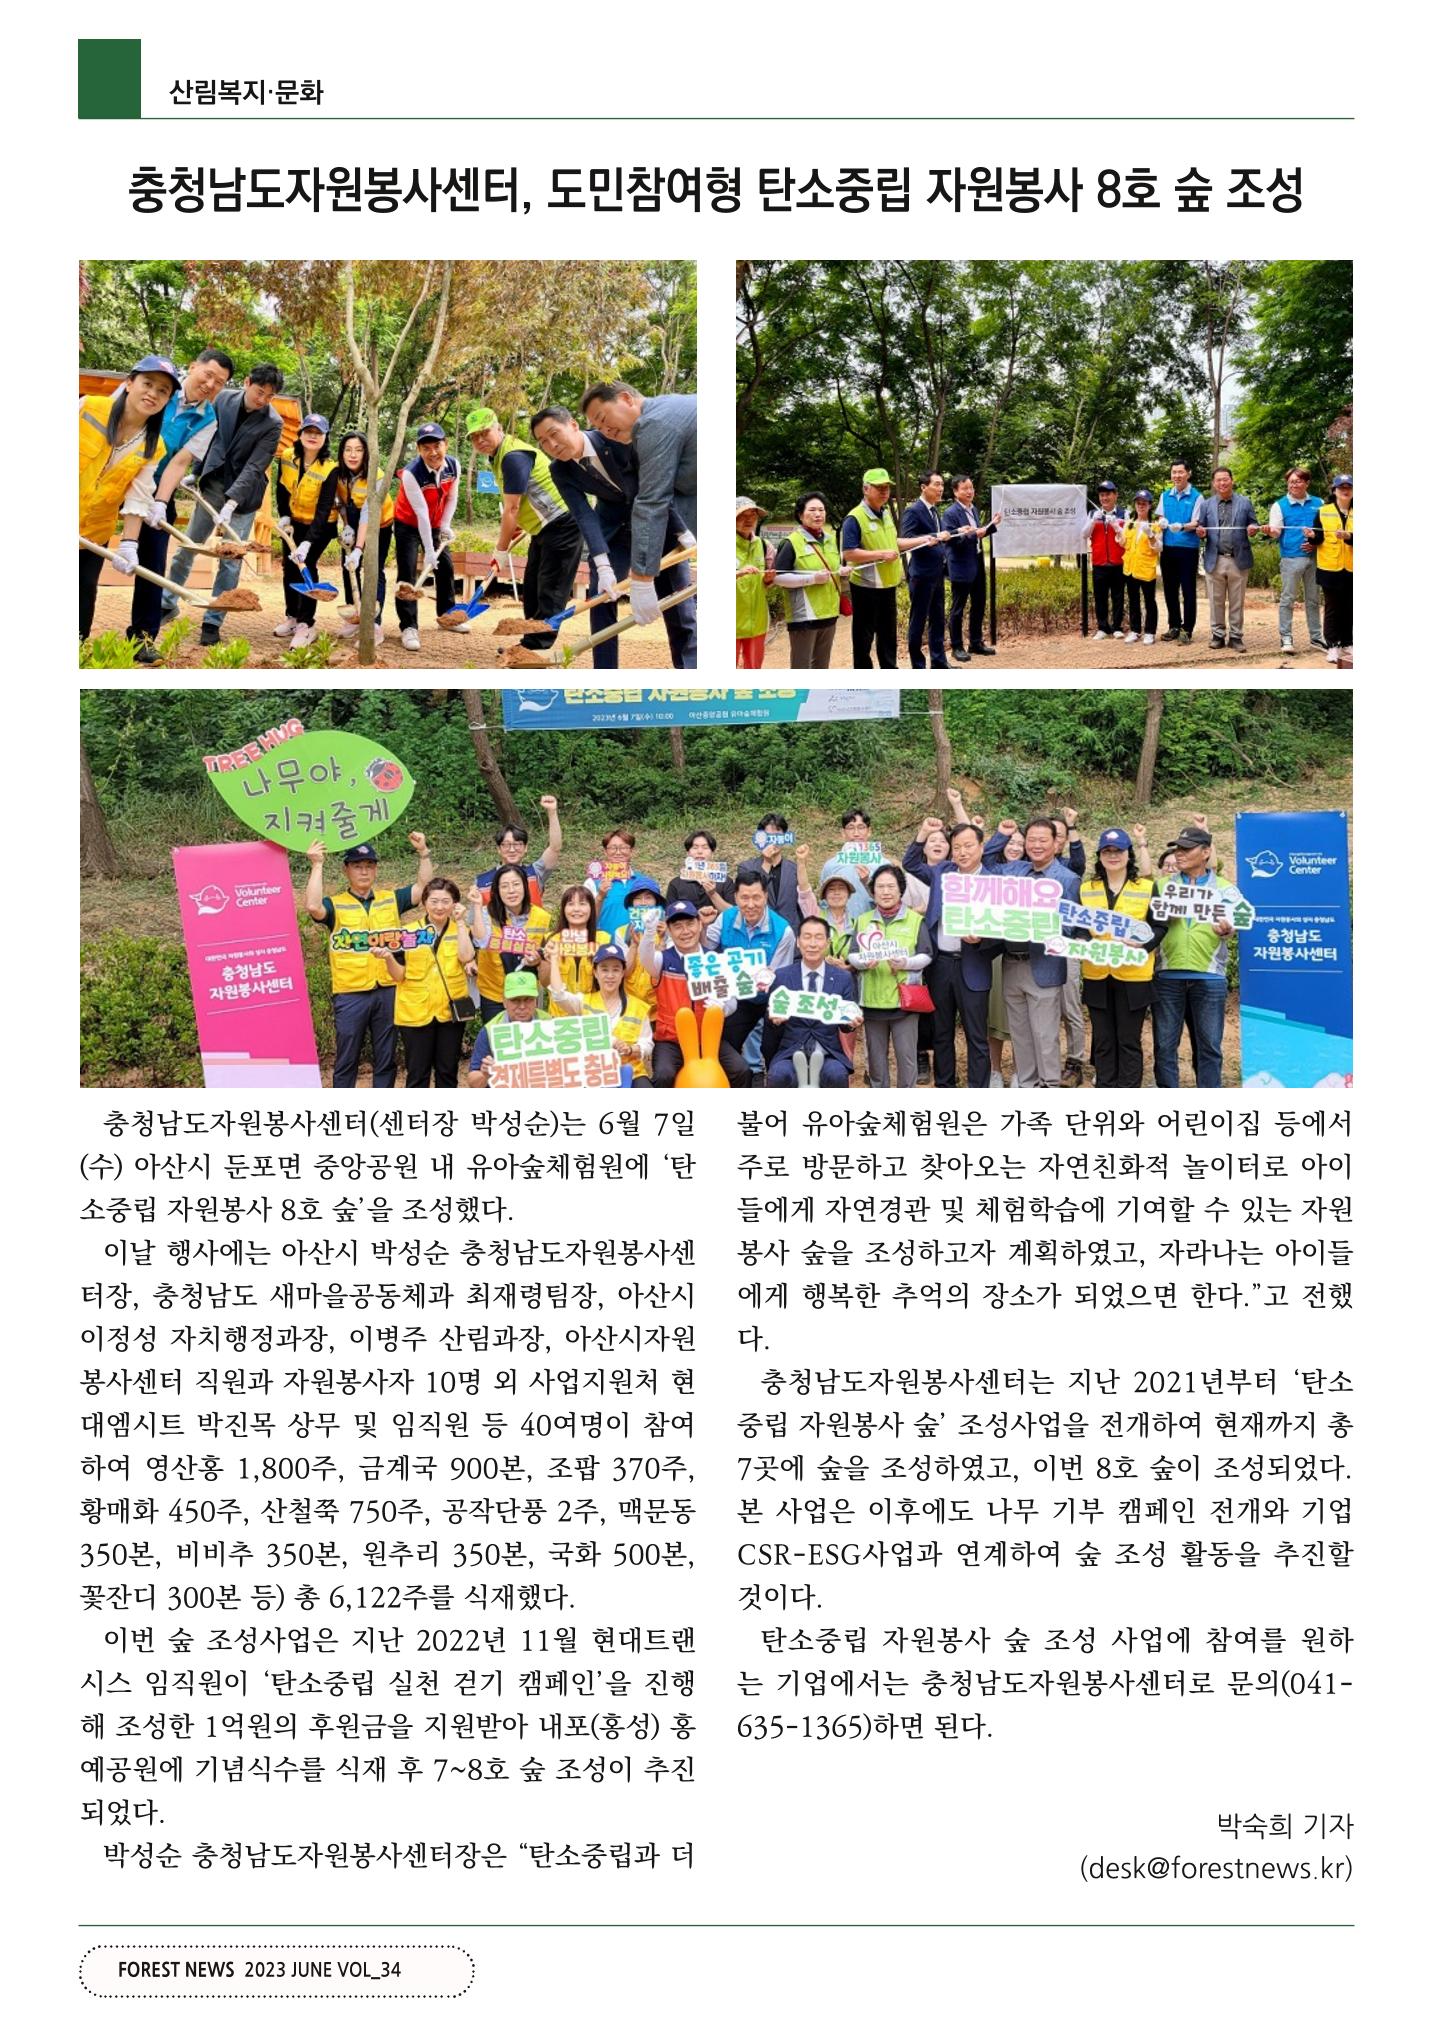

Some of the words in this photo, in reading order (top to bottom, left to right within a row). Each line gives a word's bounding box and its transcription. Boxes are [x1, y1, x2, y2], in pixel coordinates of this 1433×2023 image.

[168, 79, 325, 106] 산림복지·문화
[128, 166, 531, 215] 충청남도자원봉사센터,
[547, 166, 741, 214] 도민참여형
[759, 166, 910, 214] 탄소중립
[926, 166, 1084, 214] 자원봉사
[1097, 167, 1161, 209] 8호
[1174, 166, 1213, 213] 숲
[1226, 166, 1302, 214] 조성
[203, 742, 263, 773] TREE
[258, 718, 305, 751] HUG
[242, 756, 357, 797] 나무야,
[264, 798, 391, 840] 지켜줄게
[1289, 856, 1337, 865] Volunteer
[1289, 865, 1322, 875] Center
[234, 886, 281, 897] Volunteer
[236, 897, 268, 908] Center
[943, 874, 1062, 908] 함께해요
[1164, 884, 1213, 900] 우리가
[943, 905, 1060, 941] 탄소중립
[1059, 901, 1131, 937] 탄소중립
[1152, 900, 1187, 918] 함께
[1194, 904, 1227, 923] 만든
[1233, 901, 1252, 927] 숲
[503, 926, 528, 942] 탄소
[1267, 928, 1322, 944] 충청남도
[687, 954, 721, 979] 좋은
[727, 951, 763, 973] 공기
[1068, 941, 1146, 965] 자원봉사
[1253, 946, 1337, 961] 자원봉사센터
[222, 961, 277, 982] 충청남도
[691, 976, 729, 999] 배출
[736, 970, 755, 996] 숲
[209, 977, 293, 1000] 자원봉사센터
[772, 988, 791, 1015] 숲
[797, 994, 839, 1020] 조성
[492, 1015, 611, 1062] 탄소중립
[490, 1056, 583, 1088] 경제특별도
[583, 1052, 619, 1087] 충남
[103, 1109, 459, 1138] 충청남도자원봉사센터(센터장
[471, 1109, 587, 1138] 박성순)는
[598, 1109, 640, 1137] 6월
[654, 1109, 694, 1137] 7일
[737, 1109, 787, 1138] 불어
[802, 1109, 988, 1138] 유아숲체험원은
[1000, 1109, 1053, 1138] 가족
[1065, 1109, 1145, 1138] 단위와
[1157, 1109, 1259, 1137] 어린이집
[1274, 1109, 1351, 1138] 등에서
[79, 1195, 155, 1224] 소중립
[167, 1195, 273, 1224] 자원봉사
[281, 1197, 323, 1221] 8호
[332, 1196, 394, 1223] 숲’을
[402, 1195, 513, 1224] 조성했다.
[736, 1239, 790, 1267] 봉사
[800, 1239, 854, 1266] 숲을
[864, 1239, 997, 1267] 조성하고자
[1008, 1239, 1145, 1268] 계획하였고,
[1158, 1239, 1264, 1267] 자라나는
[1275, 1239, 1354, 1267] 아이들
[81, 1282, 139, 1311] 터장,
[152, 1282, 258, 1310] 충청남도
[269, 1282, 455, 1310] 새마을공동체과
[466, 1282, 604, 1311] 최재령팀장,
[618, 1282, 693, 1310] 아산시
[79, 1368, 181, 1396] 봉사센터
[195, 1368, 274, 1396] 직원과
[283, 1368, 415, 1396] 자원봉사자
[427, 1368, 480, 1396] 10명
[494, 1368, 516, 1396] 외
[528, 1368, 657, 1396] 사업지원처
[671, 1368, 695, 1395] 현
[760, 1368, 1055, 1396] 충청남도자원봉사센터는
[1068, 1368, 1121, 1396] 지난
[1134, 1368, 1276, 1396] 2021년부터
[1294, 1368, 1354, 1395] ‘탄소
[80, 1454, 130, 1482] 하여
[146, 1454, 225, 1482] 영산홍
[239, 1455, 344, 1484] 1,800주,
[358, 1454, 438, 1482] 금계국
[450, 1455, 532, 1483] 900본,
[547, 1454, 601, 1482] 조팝
[612, 1455, 694, 1484] 370주,
[737, 1540, 943, 1568] CSR-ESG사업과
[957, 1540, 1059, 1568] 연계하여
[1074, 1540, 1102, 1568] 숲
[1114, 1540, 1165, 1568] 조성
[1180, 1540, 1261, 1568] 활동을
[1273, 1540, 1355, 1569] 추진할
[79, 1583, 155, 1611] 꽃잔디
[168, 1584, 242, 1611] 300본
[250, 1583, 285, 1612] 등)
[293, 1583, 321, 1611] 총
[329, 1584, 455, 1613] 6,122주를
[464, 1583, 575, 1611] 식재했다.
[736, 1671, 764, 1696] 는
[777, 1669, 910, 1697] 기업에서는
[921, 1669, 1215, 1697] 충청남도자원봉사센터로
[1227, 1669, 1353, 1698] 문의(041-
[80, 1712, 104, 1740] 해
[115, 1712, 195, 1740] 조성한
[206, 1712, 296, 1741] 1억원의
[308, 1712, 414, 1741] 후원금을
[424, 1712, 529, 1740] 지원받아
[538, 1712, 660, 1741] 내포(홍성)
[669, 1712, 697, 1740] 홍
[737, 1712, 924, 1741] 635-1365)하면
[934, 1712, 992, 1740] 된다.
[80, 1798, 165, 1827] 되었다.
[1218, 1812, 1292, 1840] 박숙희
[1304, 1812, 1355, 1840] 기자
[103, 1841, 182, 1870] 박성순
[191, 1841, 507, 1870] 충청남도자원봉사센터장은
[519, 1841, 661, 1870] “탄소중립과
[671, 1841, 693, 1870] 더
[1080, 1854, 1353, 1883] (desk@forestnews.kr)
[118, 1960, 181, 1978] FOREST
[185, 1960, 235, 1978] NEWS
[244, 1961, 286, 1978] 2023
[290, 1961, 332, 1978] JUNE
[336, 1961, 402, 1980] VOL_34
